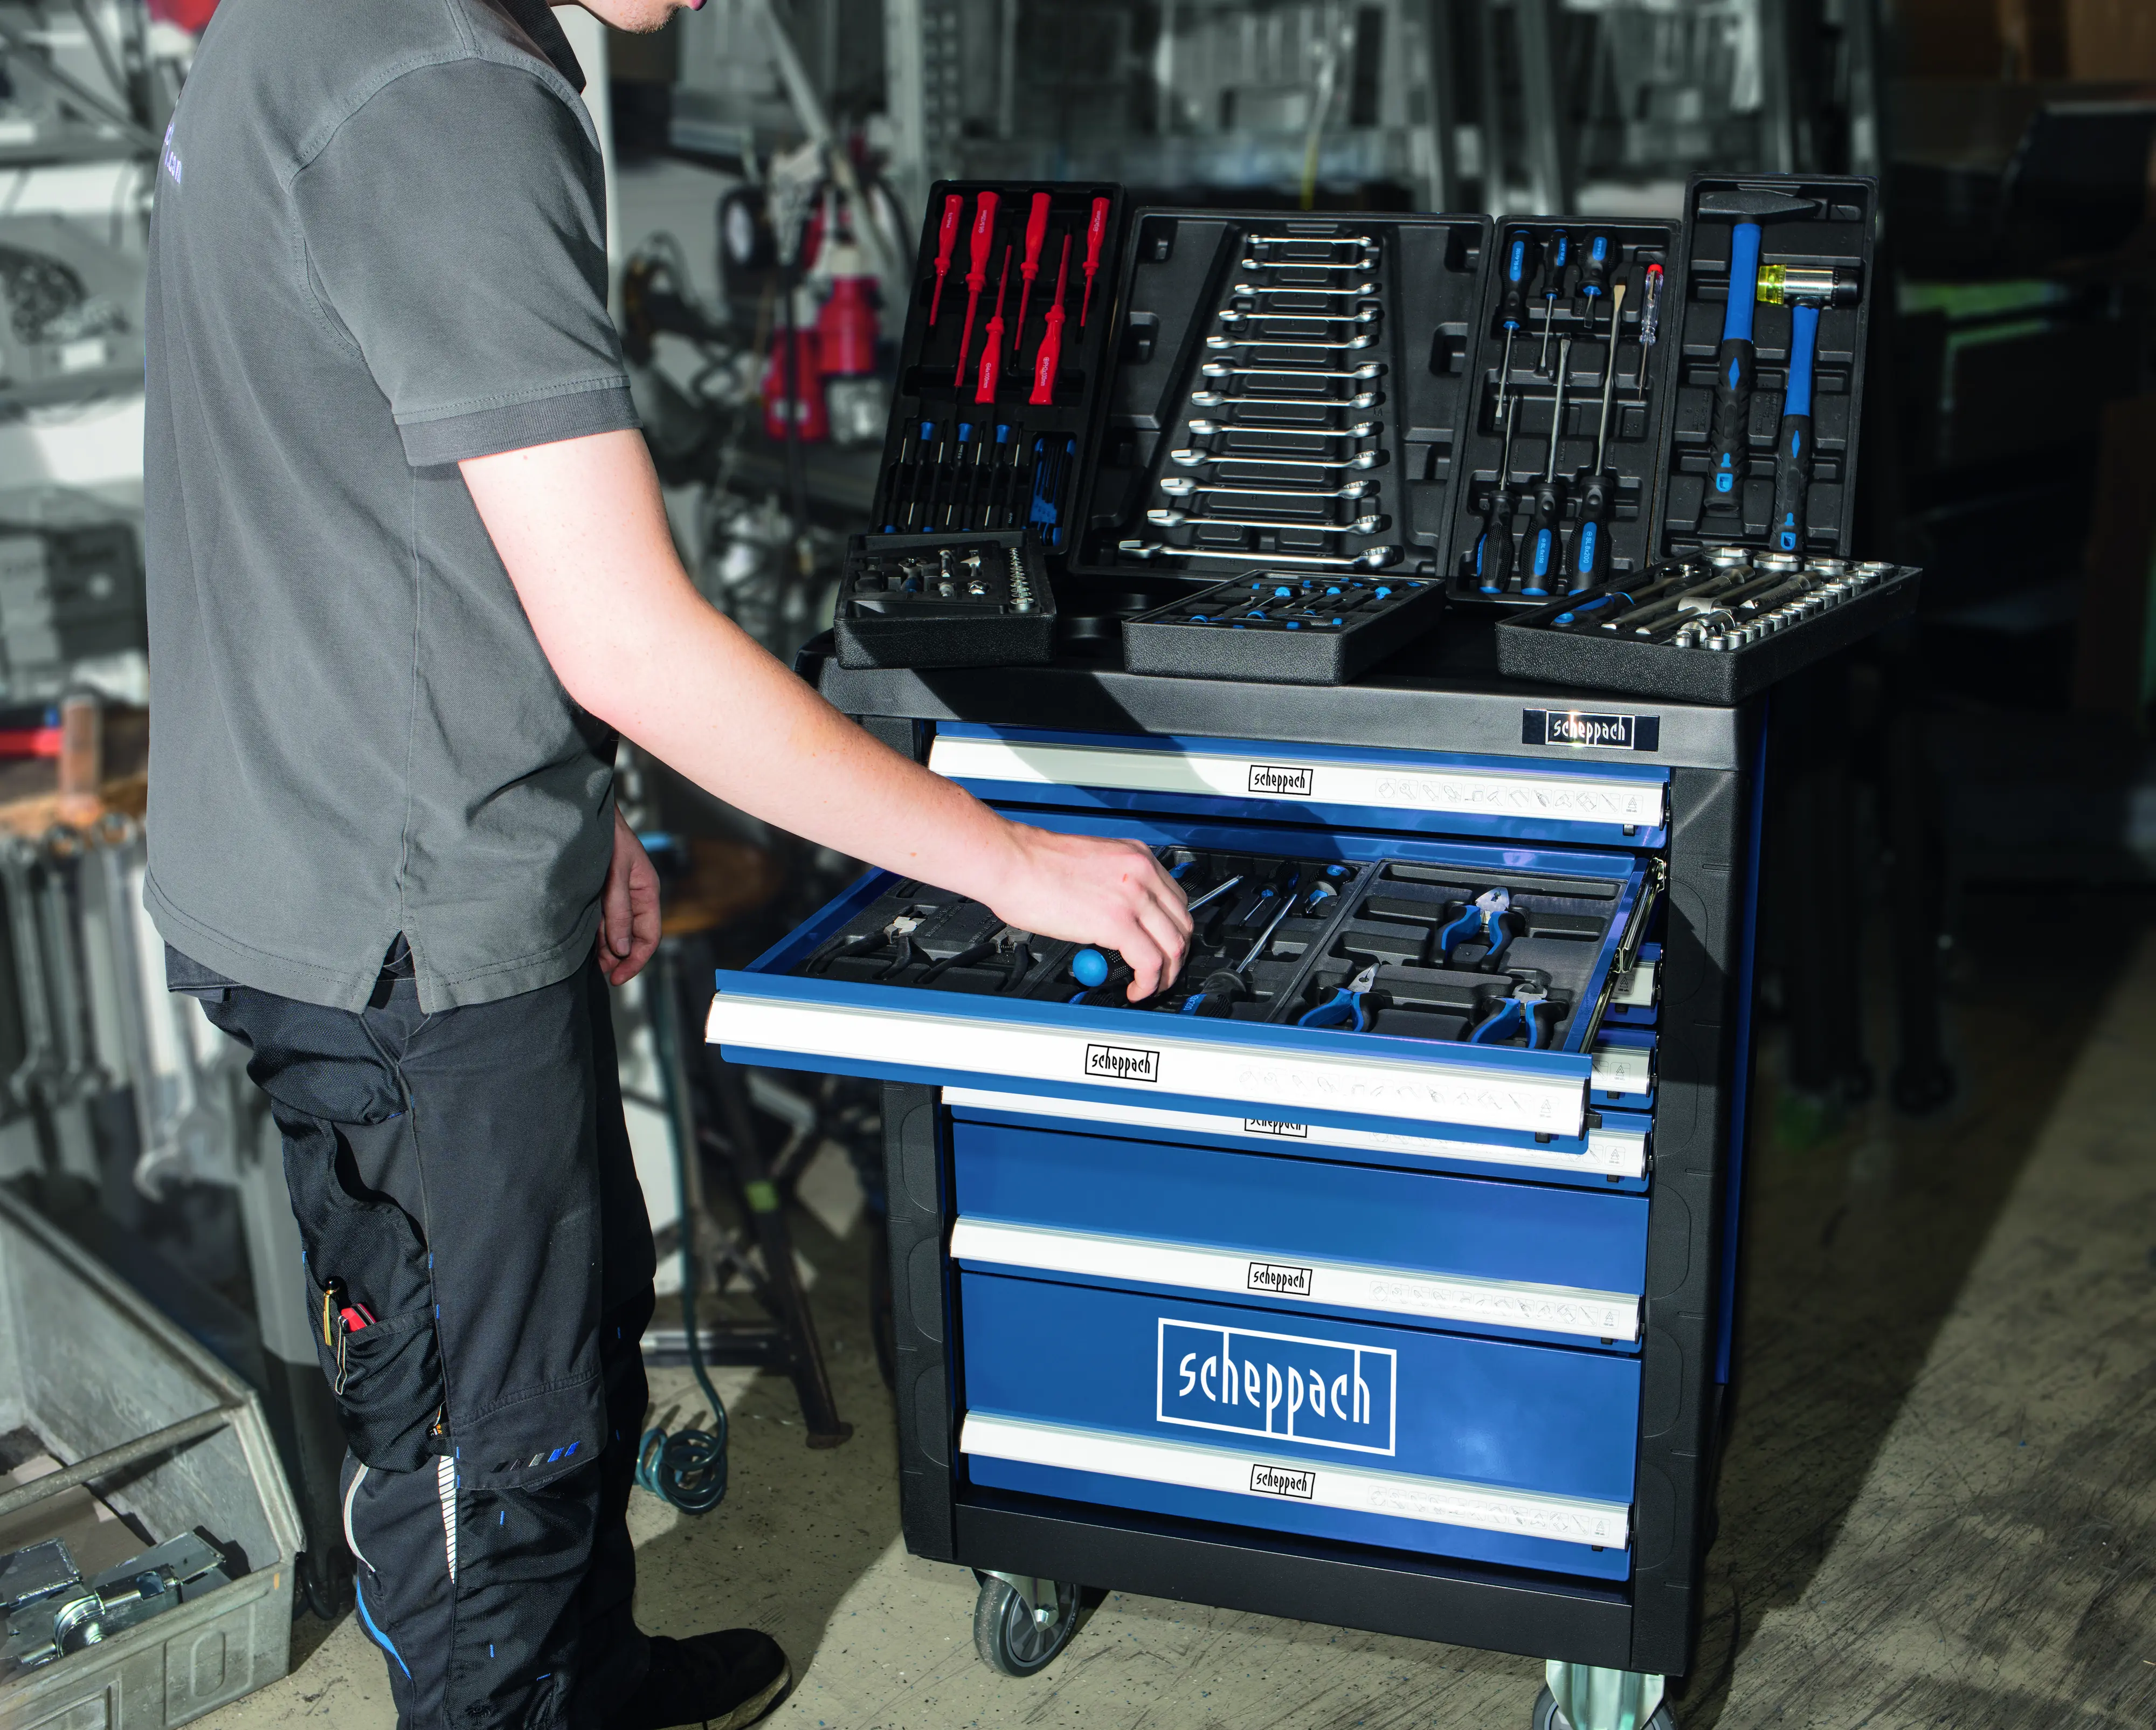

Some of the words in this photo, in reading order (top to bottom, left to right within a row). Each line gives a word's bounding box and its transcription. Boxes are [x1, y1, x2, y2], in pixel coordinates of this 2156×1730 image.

[1585, 536, 1592, 544] SL
[1583, 546, 1591, 563] 8x200
[1554, 714, 1625, 746] scheppach
[1255, 767, 1305, 792] scheppach
[1092, 1047, 1150, 1077] scheppach
[1254, 1265, 1304, 1291] scheppach
[1179, 1332, 1370, 1435] scheppach
[1256, 1468, 1307, 1494] scheppach
